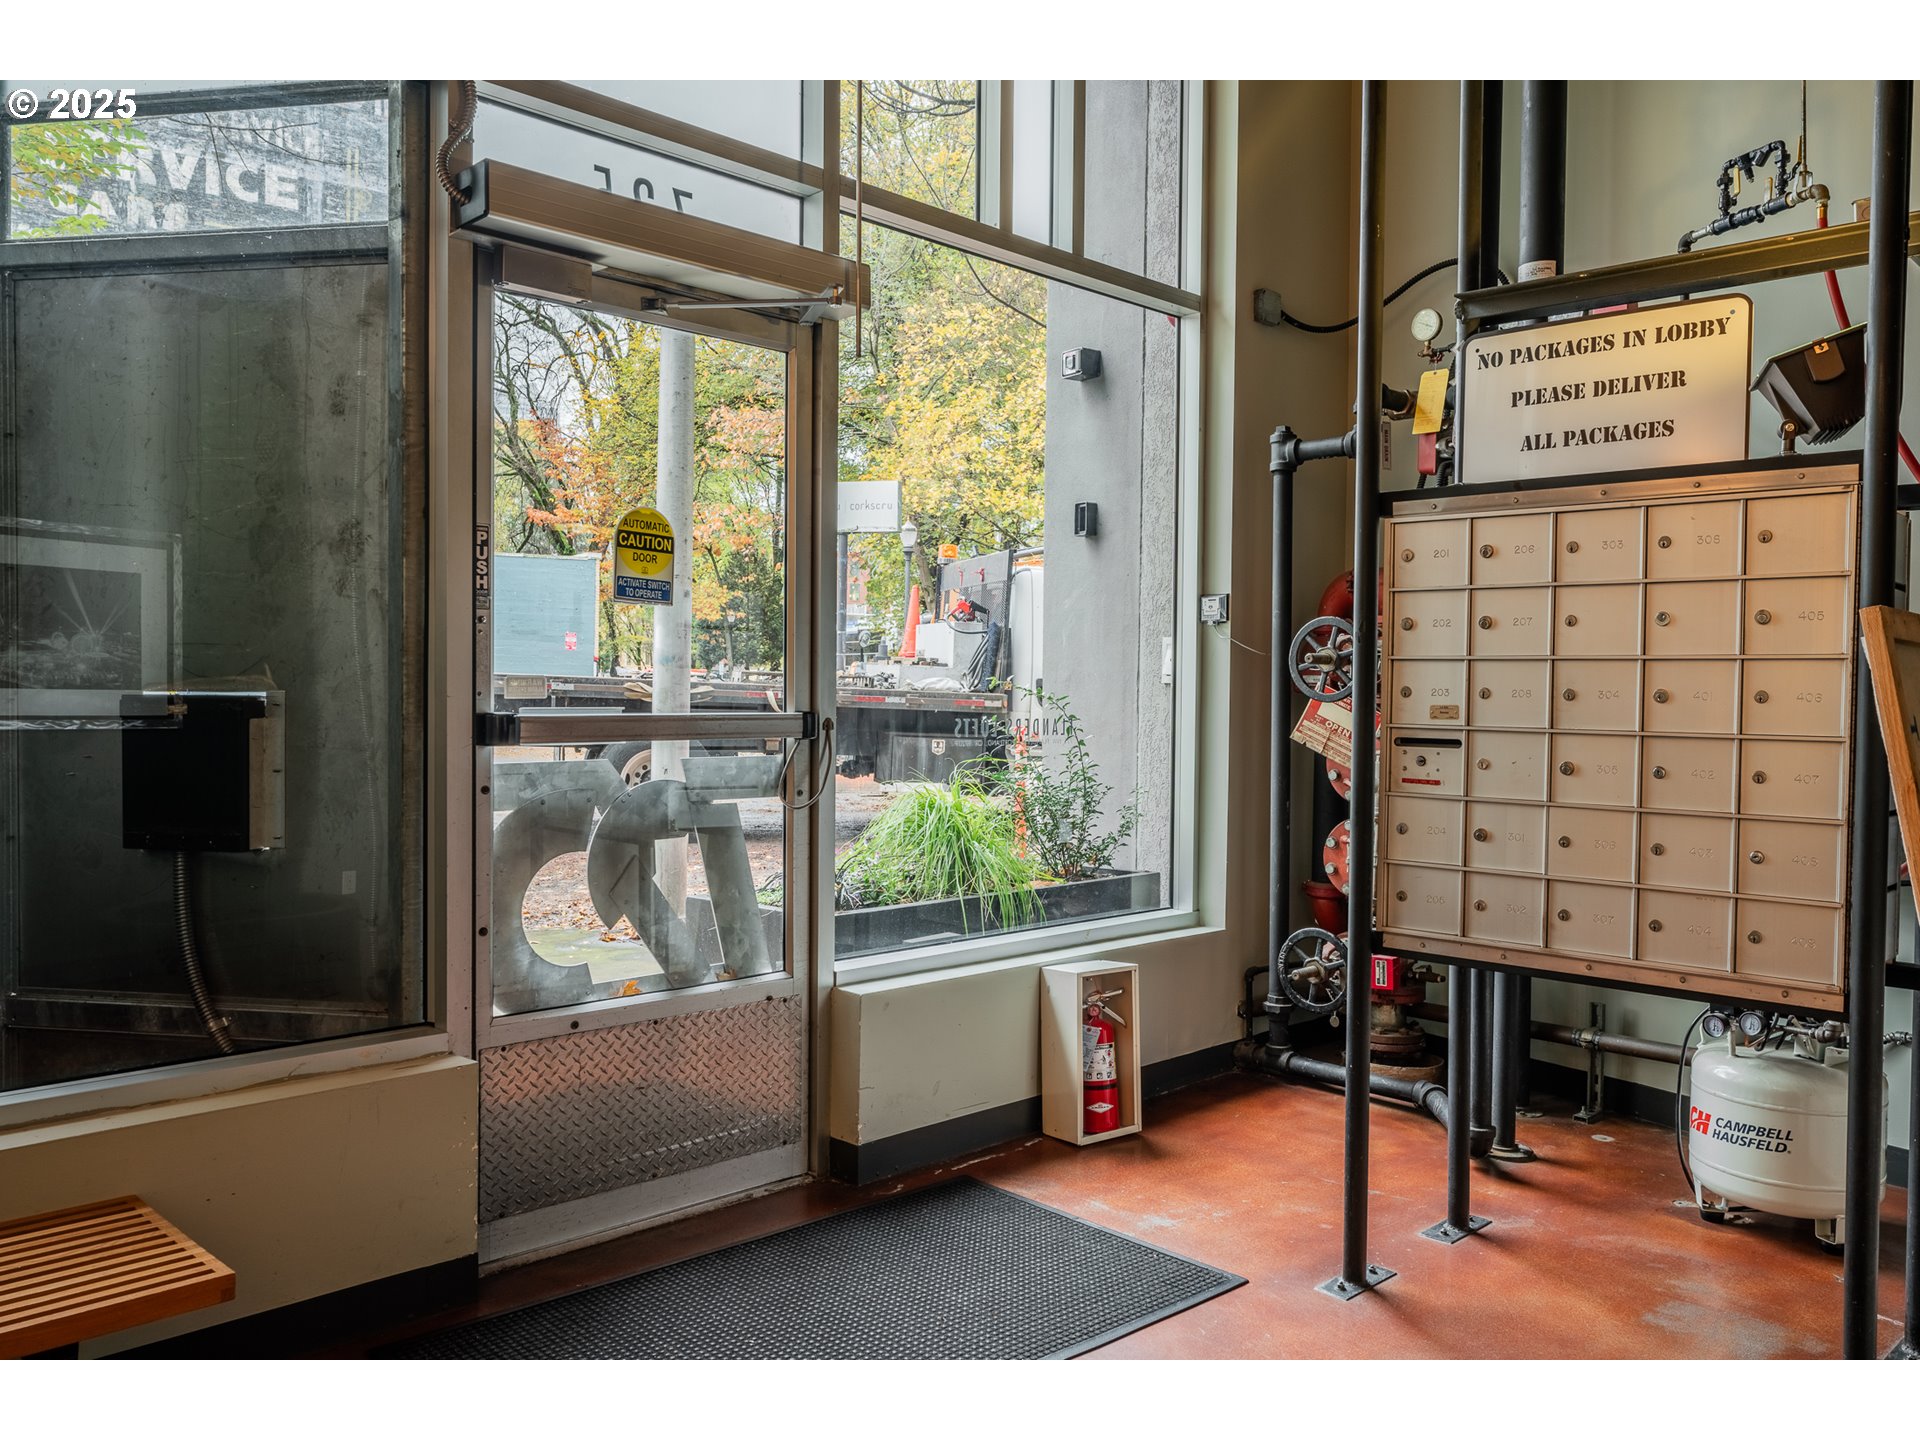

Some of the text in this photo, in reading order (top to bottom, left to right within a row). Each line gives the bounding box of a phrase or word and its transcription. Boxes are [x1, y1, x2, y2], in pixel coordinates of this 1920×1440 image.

[1477, 316, 1732, 371] NO PACKAGES IN LOBBY
[1510, 369, 1688, 409] PLEASE DELIVER
[1519, 419, 1676, 452] ALL PACKAGES
[849, 499, 893, 511] corkscru
[623, 518, 670, 533] AUTOMATIC
[619, 532, 672, 551] CAUTION
[1601, 539, 1624, 550] 303
[1433, 549, 1449, 558] 201
[1514, 545, 1535, 554] 206
[475, 531, 488, 589] PUSH
[632, 552, 658, 564] DOOR
[618, 577, 670, 591] ACTIVATE SWITCH
[626, 588, 662, 599] TO OPERATE
[1798, 610, 1825, 621] 405
[1432, 618, 1452, 628] 202
[1512, 617, 1533, 627] 207
[1430, 687, 1450, 697] 203
[1511, 689, 1532, 698] 208
[1598, 690, 1620, 699] 304
[1325, 719, 1353, 739] OPEN
[1793, 774, 1820, 785] 407
[1426, 825, 1446, 836] 204
[1715, 1117, 1794, 1142] CAMPBELL
